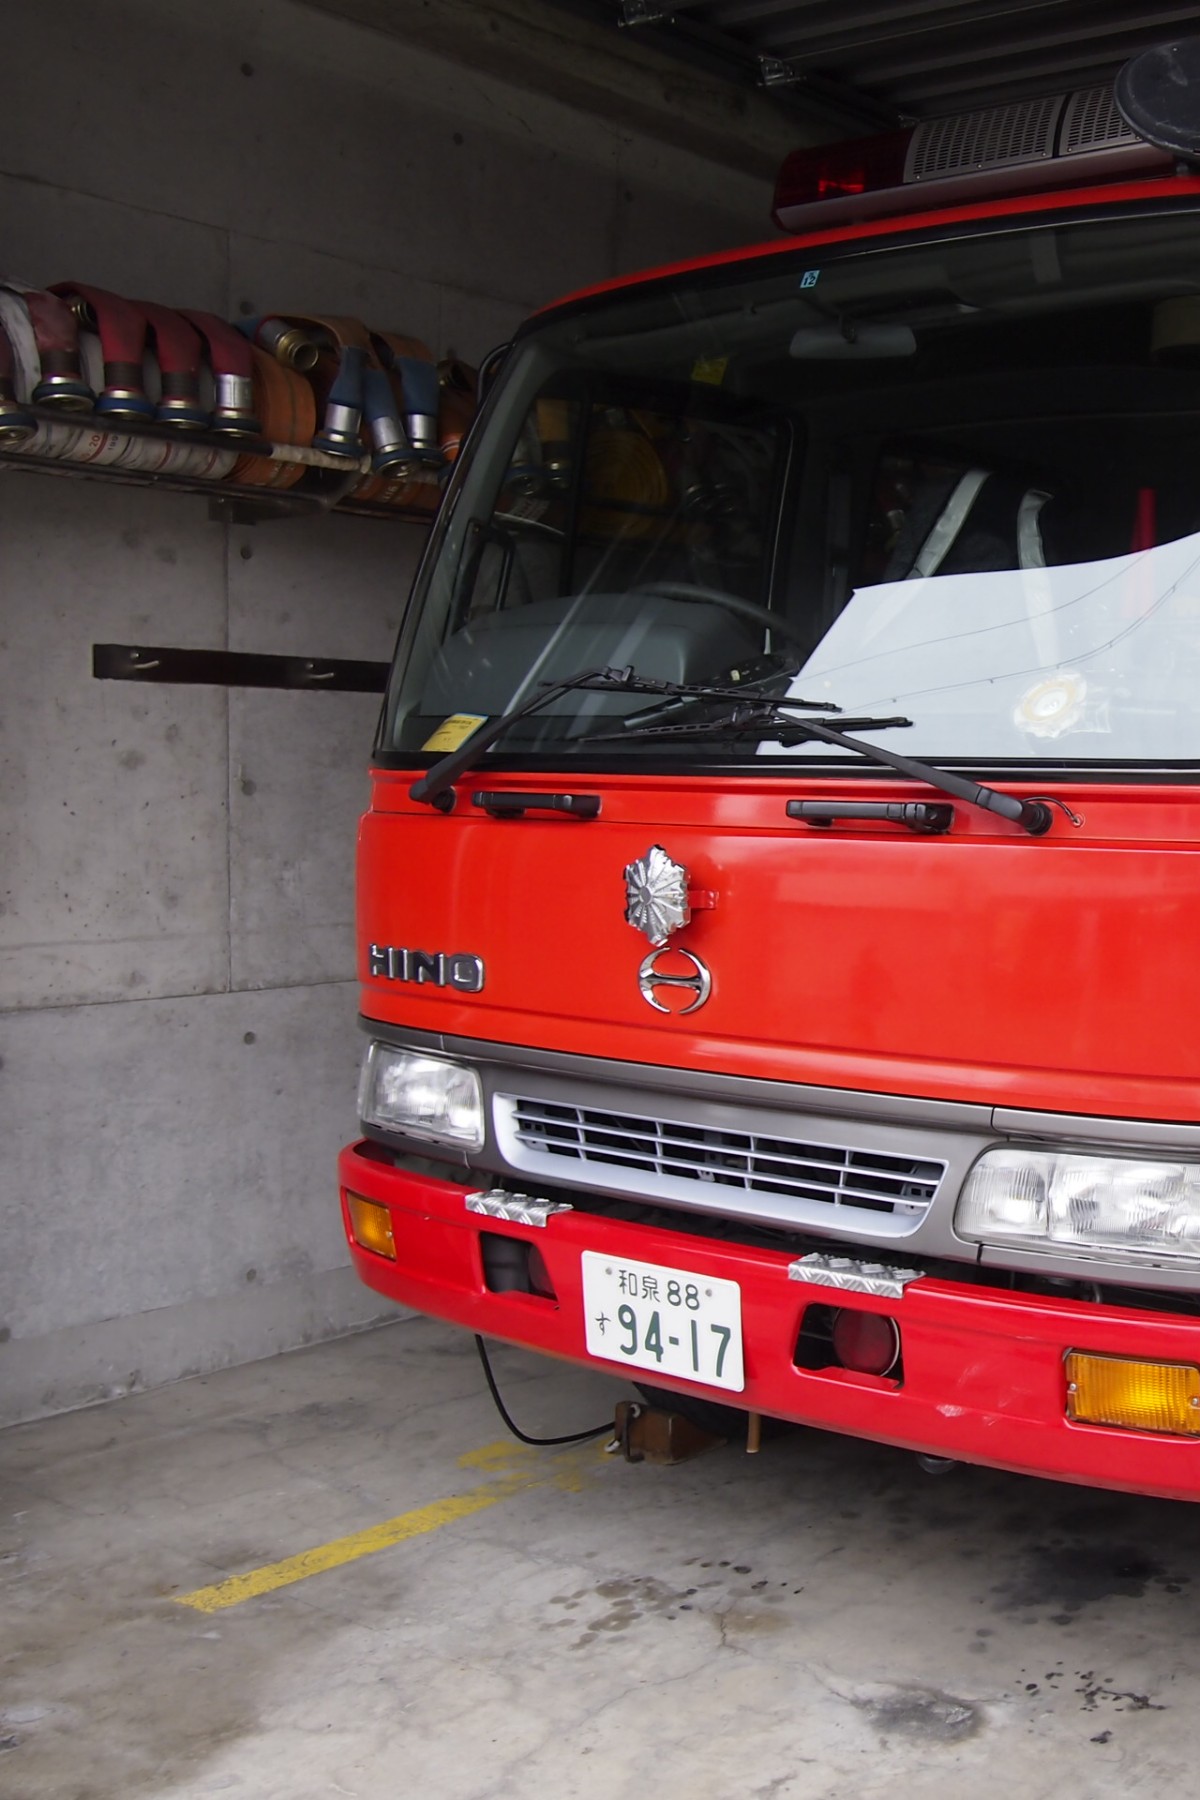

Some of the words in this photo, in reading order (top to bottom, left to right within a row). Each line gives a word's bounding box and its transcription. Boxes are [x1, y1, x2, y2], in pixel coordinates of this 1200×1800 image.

[369, 943, 485, 993] HINO
[595, 1312, 611, 1336] す
[617, 1304, 731, 1378] 94-17
